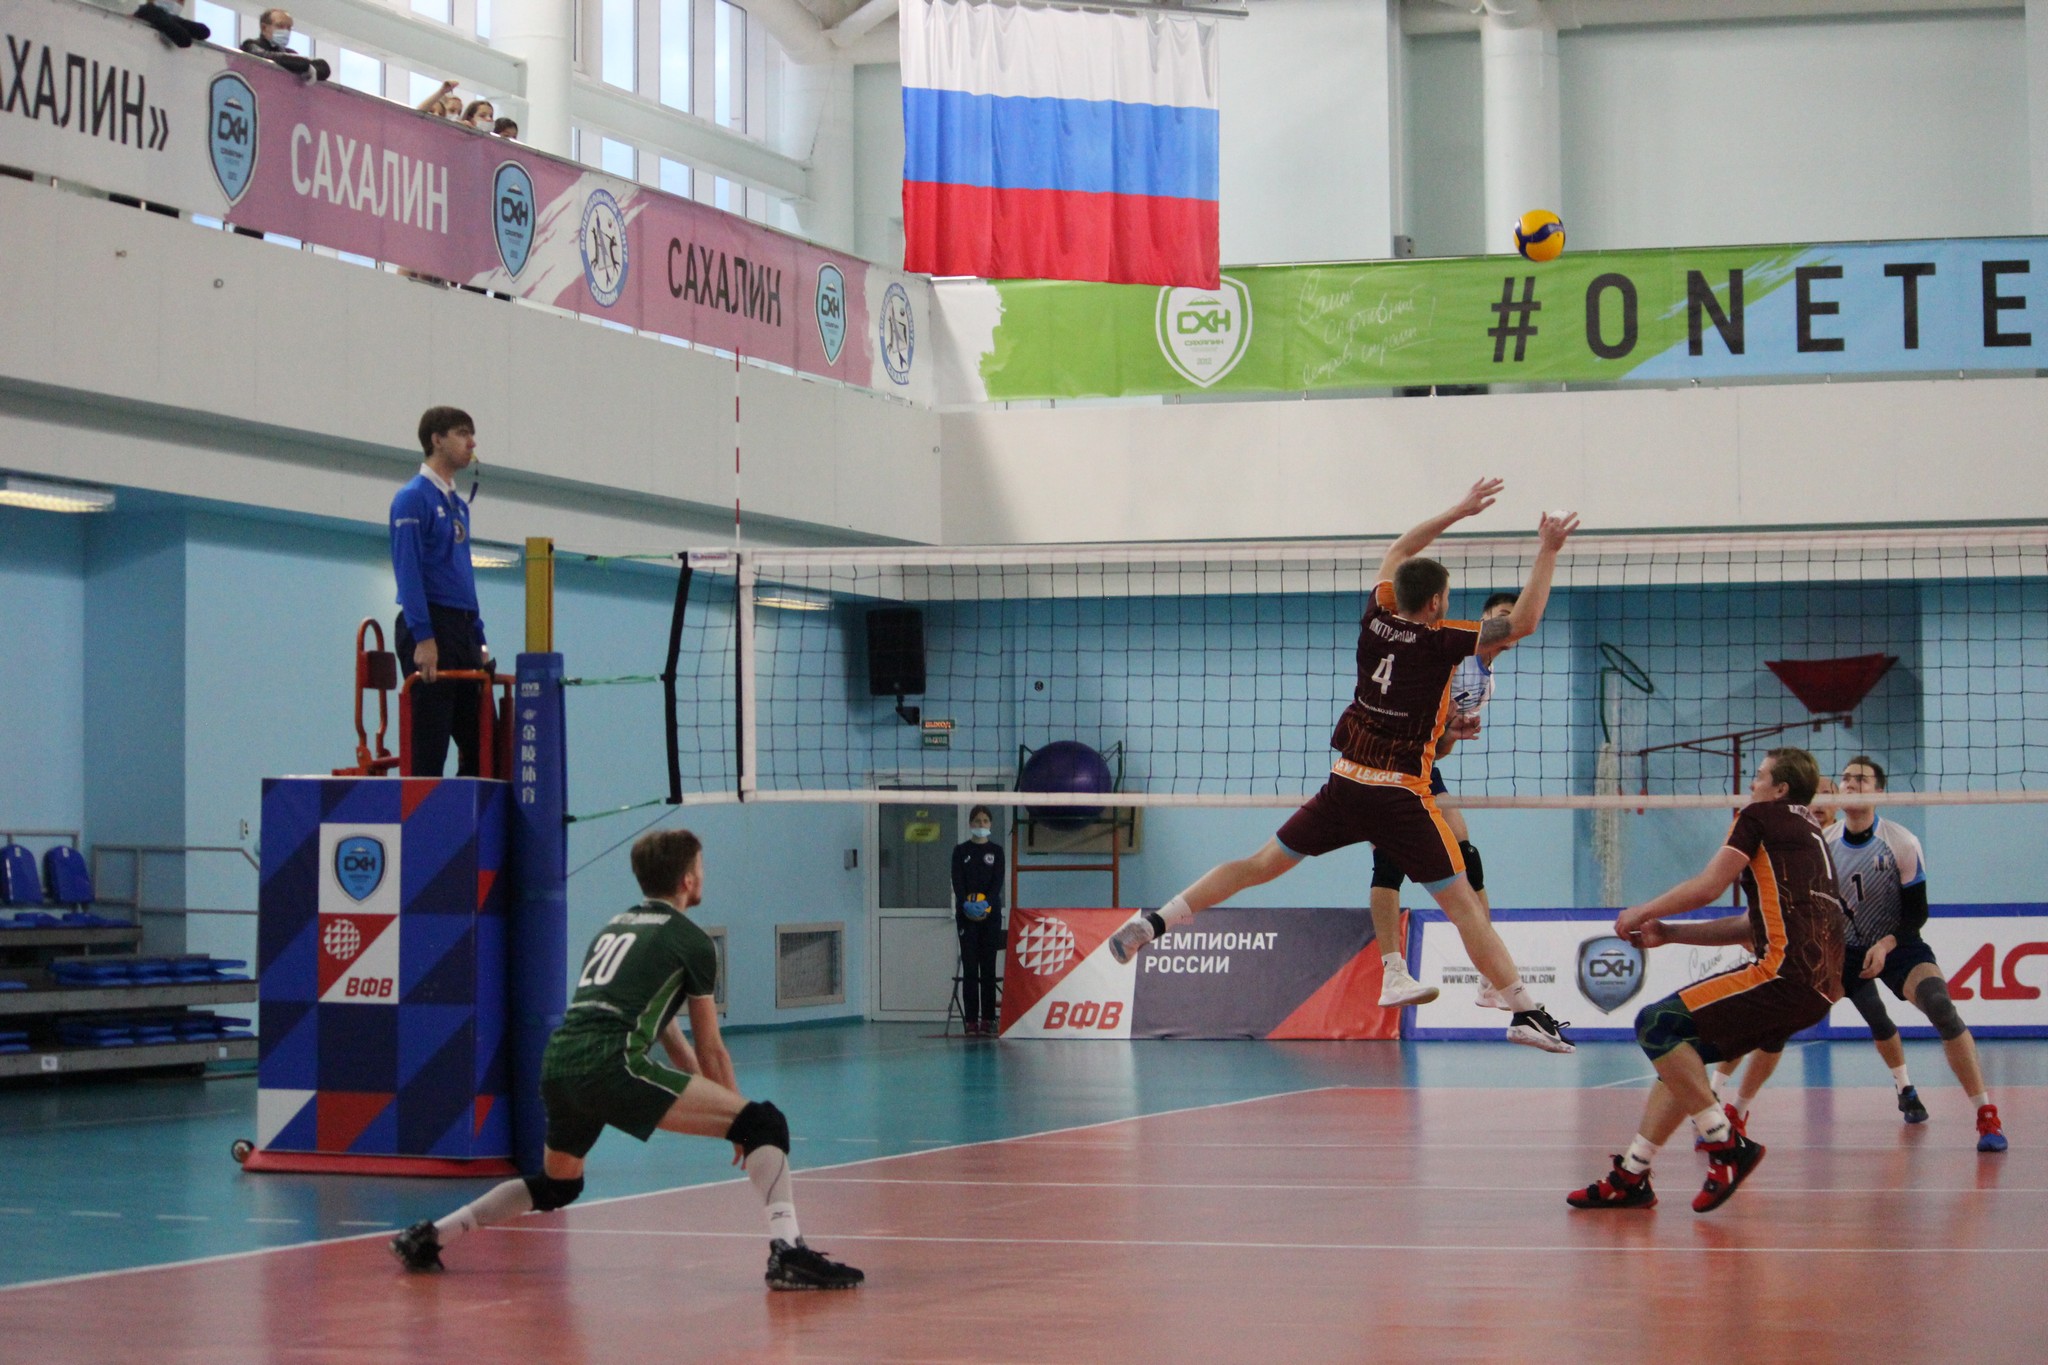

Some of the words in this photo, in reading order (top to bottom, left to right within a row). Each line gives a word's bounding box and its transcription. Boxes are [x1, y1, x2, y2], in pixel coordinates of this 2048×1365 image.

[0, 34, 169, 151] ХАЛИН»
[291, 123, 448, 234] САХАЛИН
[667, 237, 782, 327] САХАЛИН
[1371, 653, 1395, 695] 4
[1355, 767, 1403, 784] LEAGUE
[1851, 873, 1864, 901] 1
[578, 932, 636, 988] 20
[1145, 955, 1230, 973] РОССИИ
[345, 977, 393, 998] ВФВ
[1043, 1000, 1124, 1030] ВФВ
